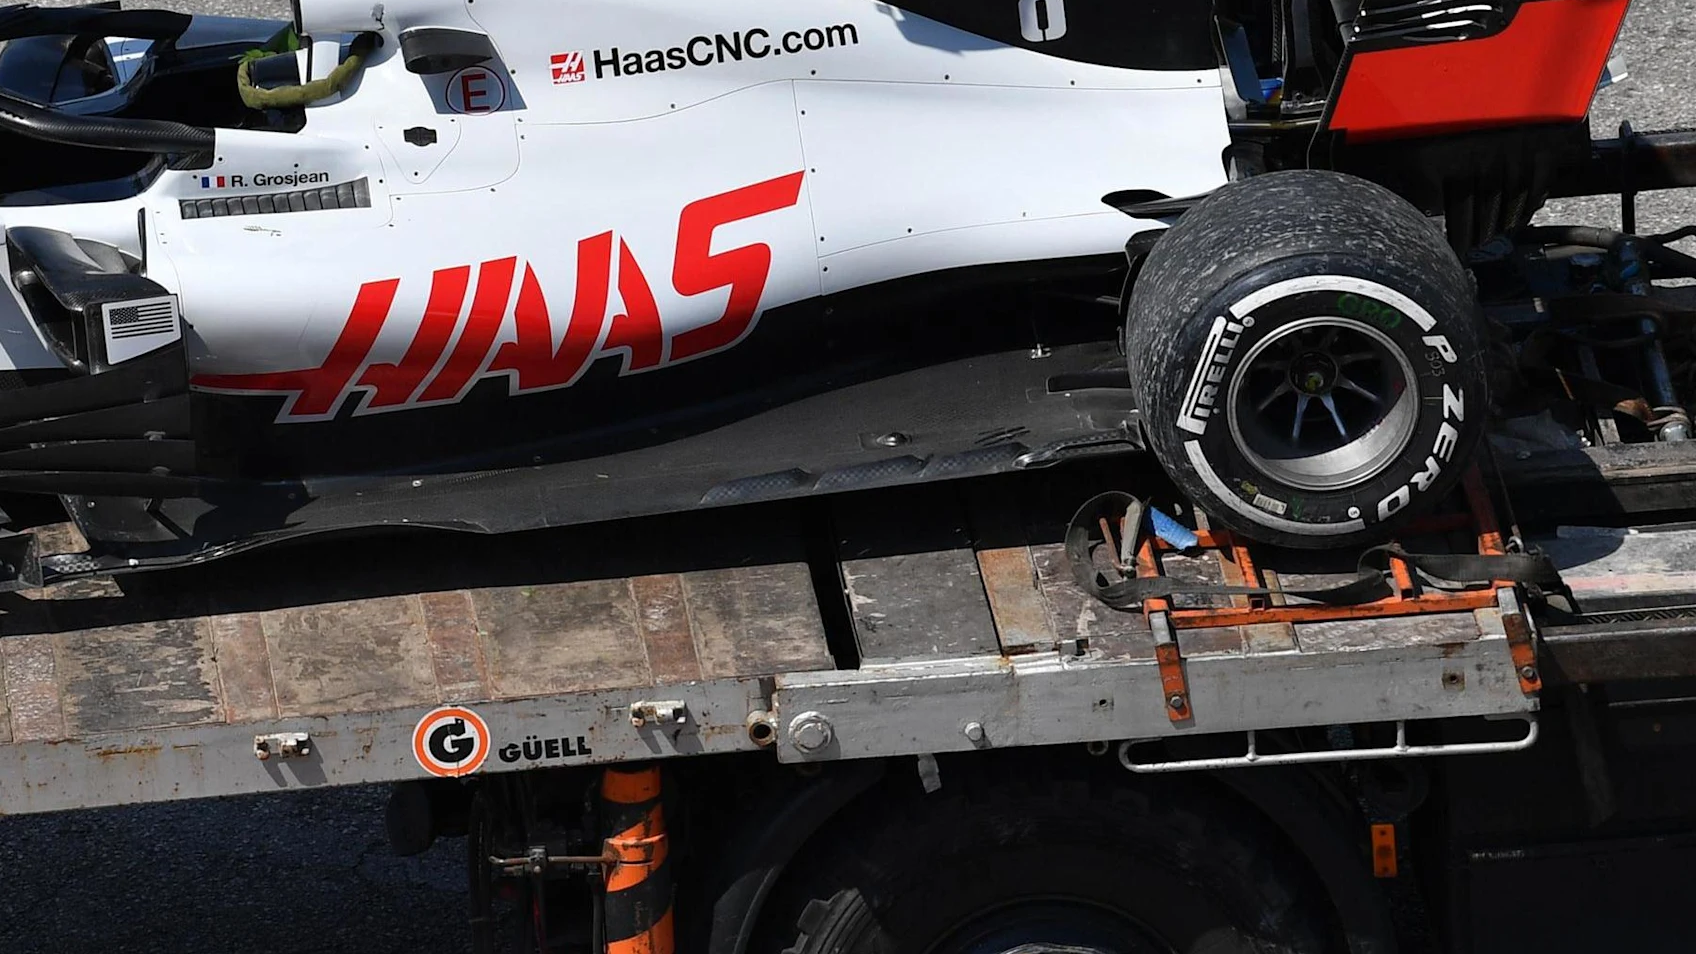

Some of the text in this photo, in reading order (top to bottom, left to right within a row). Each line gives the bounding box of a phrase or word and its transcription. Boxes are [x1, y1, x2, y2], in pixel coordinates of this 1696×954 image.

[594, 22, 859, 79] HaasCNC.com
[461, 73, 491, 112] E
[231, 171, 330, 191] R. Grosjean
[190, 170, 805, 416] HAAS
[1176, 315, 1244, 435] PIRELLI
[1377, 334, 1465, 522] P ZERO
[498, 734, 592, 763] GÜELL
